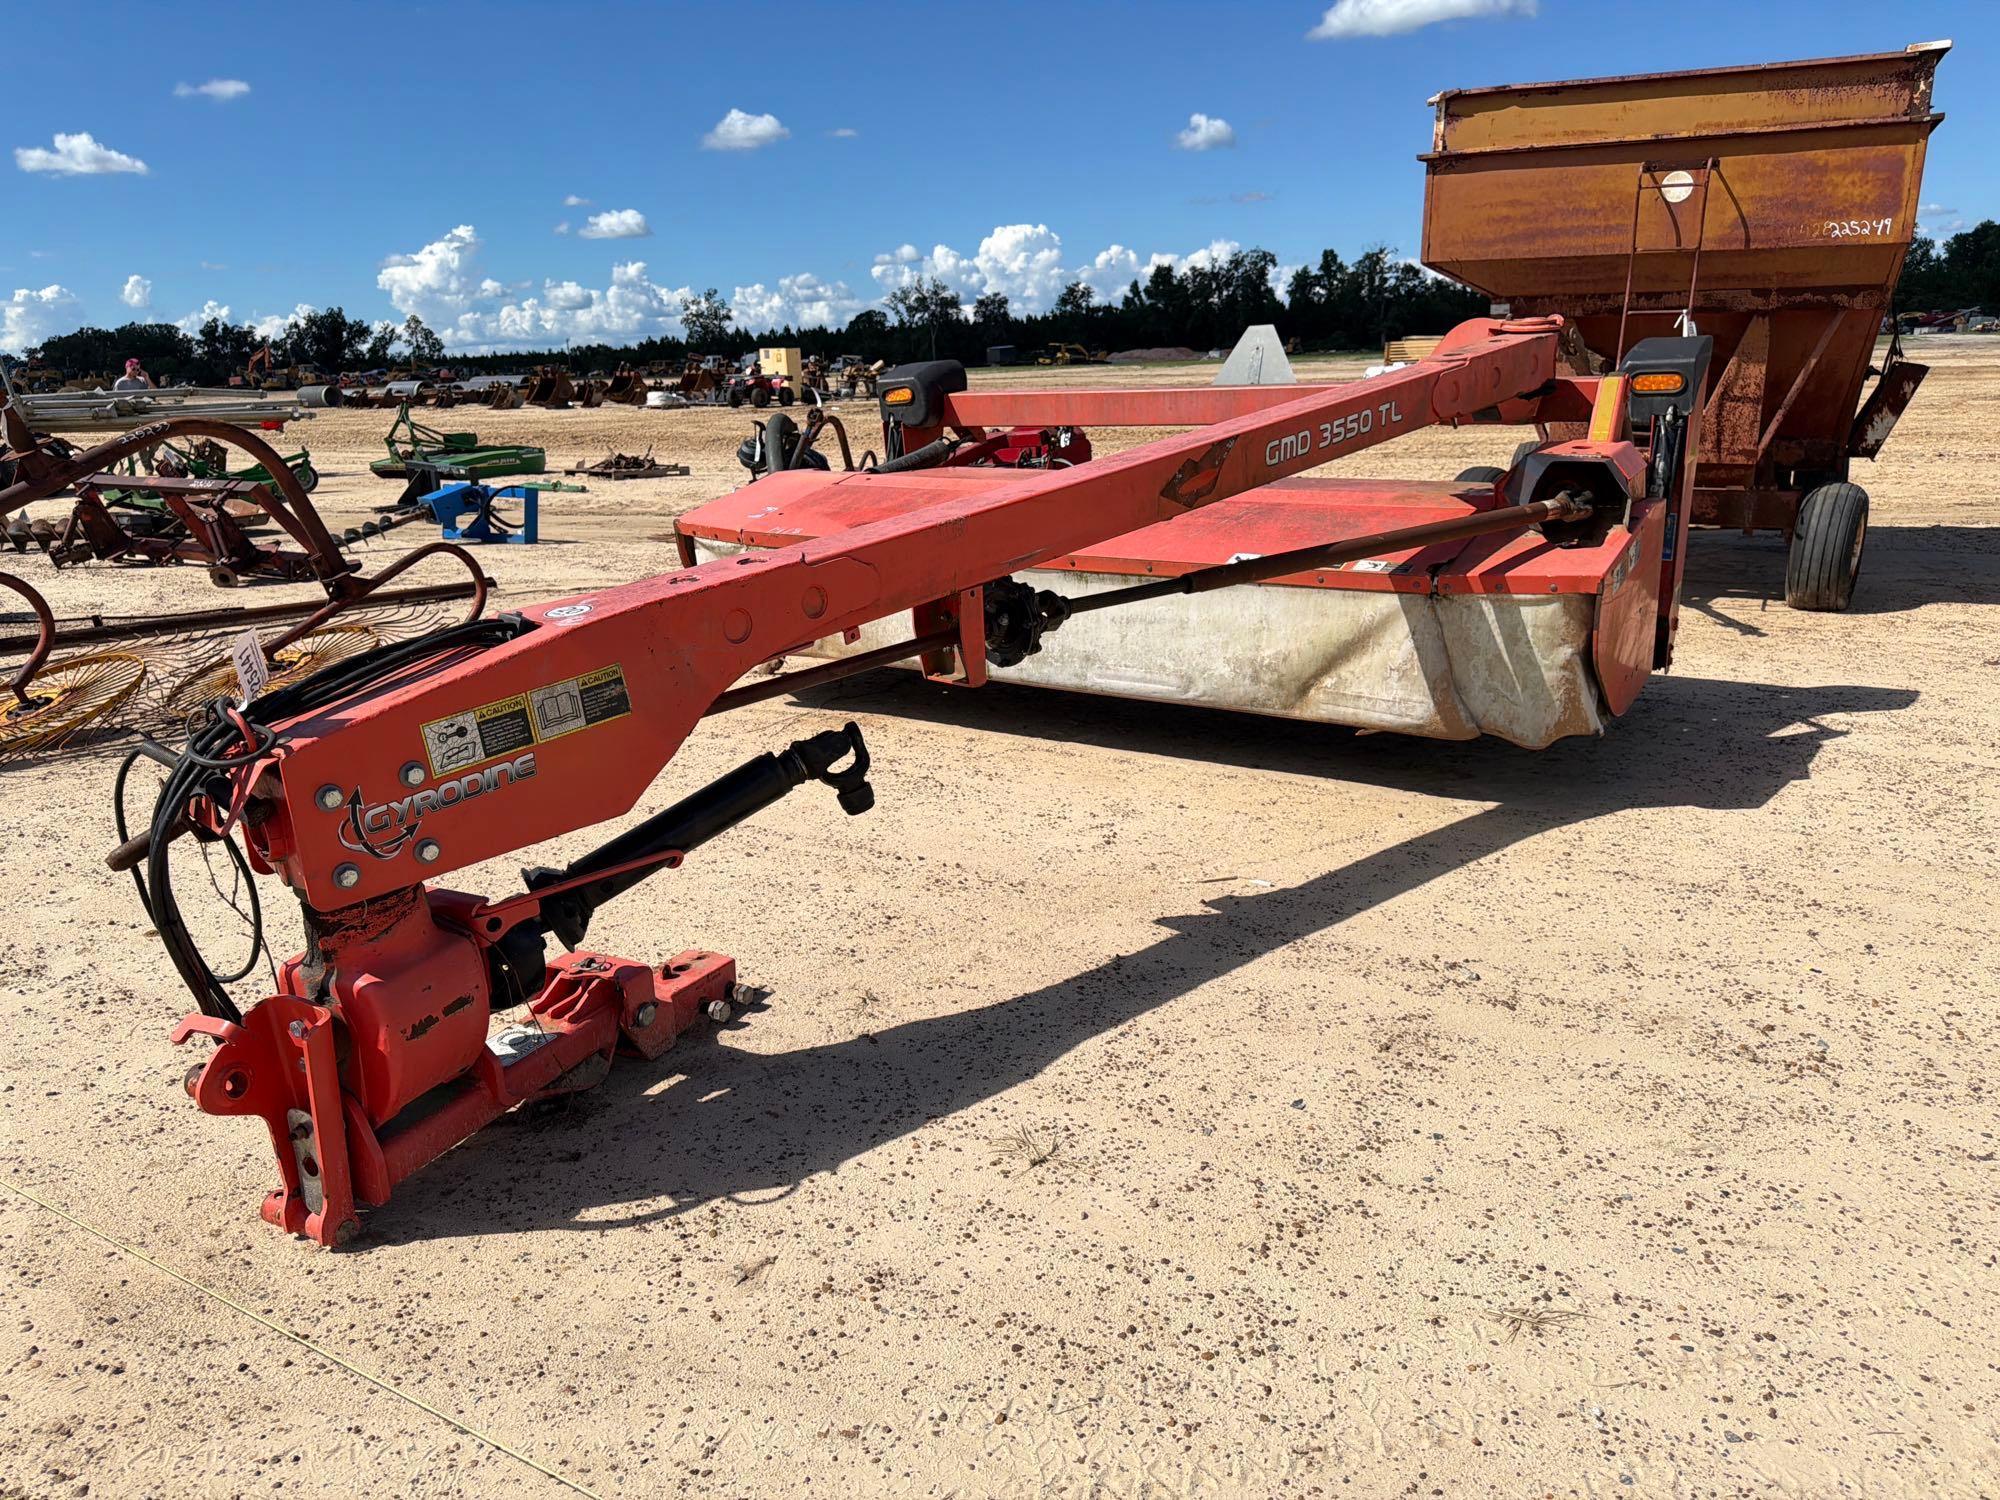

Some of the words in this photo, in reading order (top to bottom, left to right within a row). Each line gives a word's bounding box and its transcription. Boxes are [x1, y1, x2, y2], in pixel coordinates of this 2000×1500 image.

[1265, 430, 1311, 466] GMD
[1318, 409, 1372, 448] 3550
[1378, 400, 1402, 426] TL
[587, 668, 619, 684] CAUTION
[485, 699, 523, 717] CAUTION
[364, 752, 537, 833] GYRODINE
